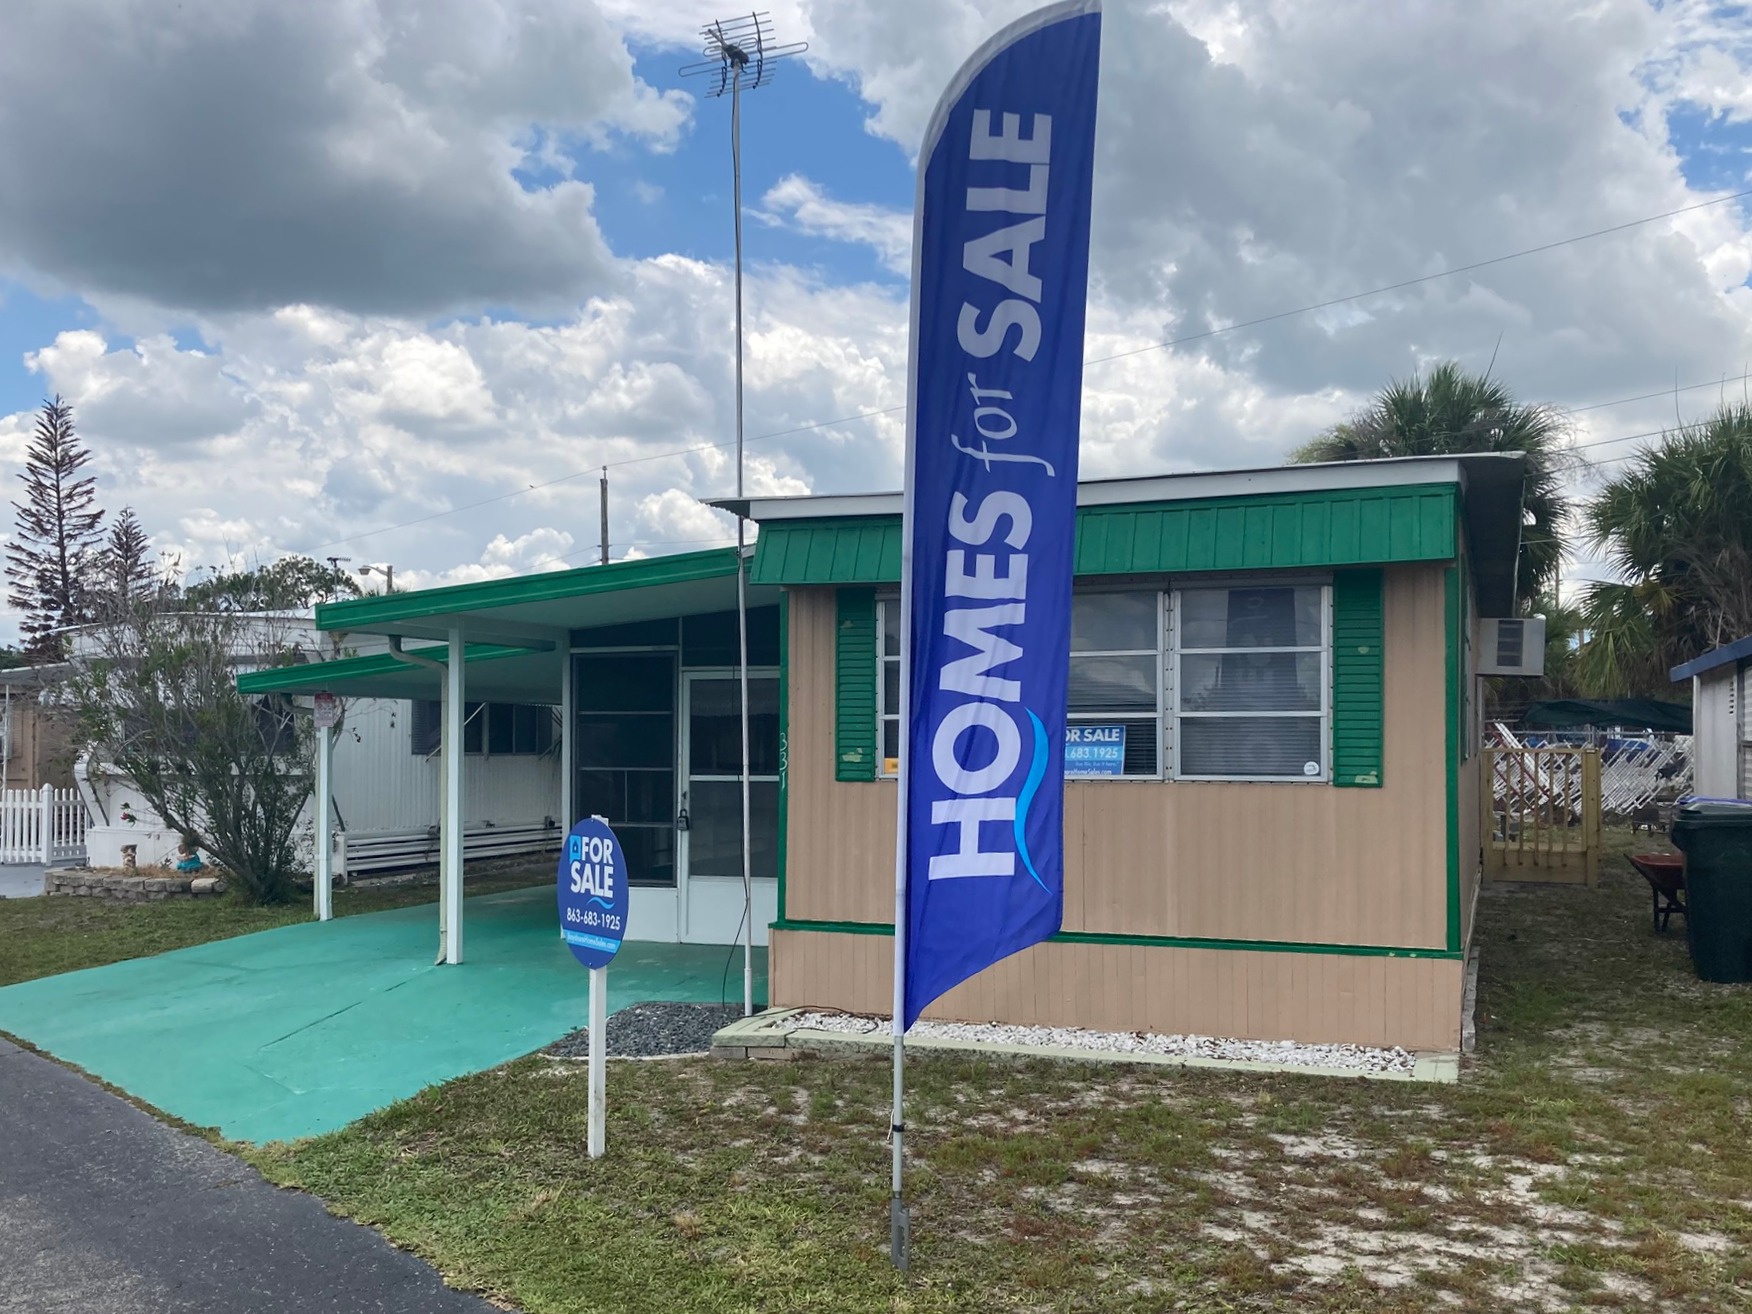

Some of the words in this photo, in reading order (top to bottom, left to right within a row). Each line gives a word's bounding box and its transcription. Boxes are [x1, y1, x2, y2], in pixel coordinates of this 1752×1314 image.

[957, 108, 1052, 363] SALE
[951, 372, 1056, 477] for
[928, 491, 1033, 881] HOMES
[1083, 728, 1120, 742] SALE
[1065, 747, 1118, 759] .683.1925
[581, 836, 614, 865] FOR
[570, 860, 614, 898] SALE
[566, 907, 621, 931] 863-683-1925
